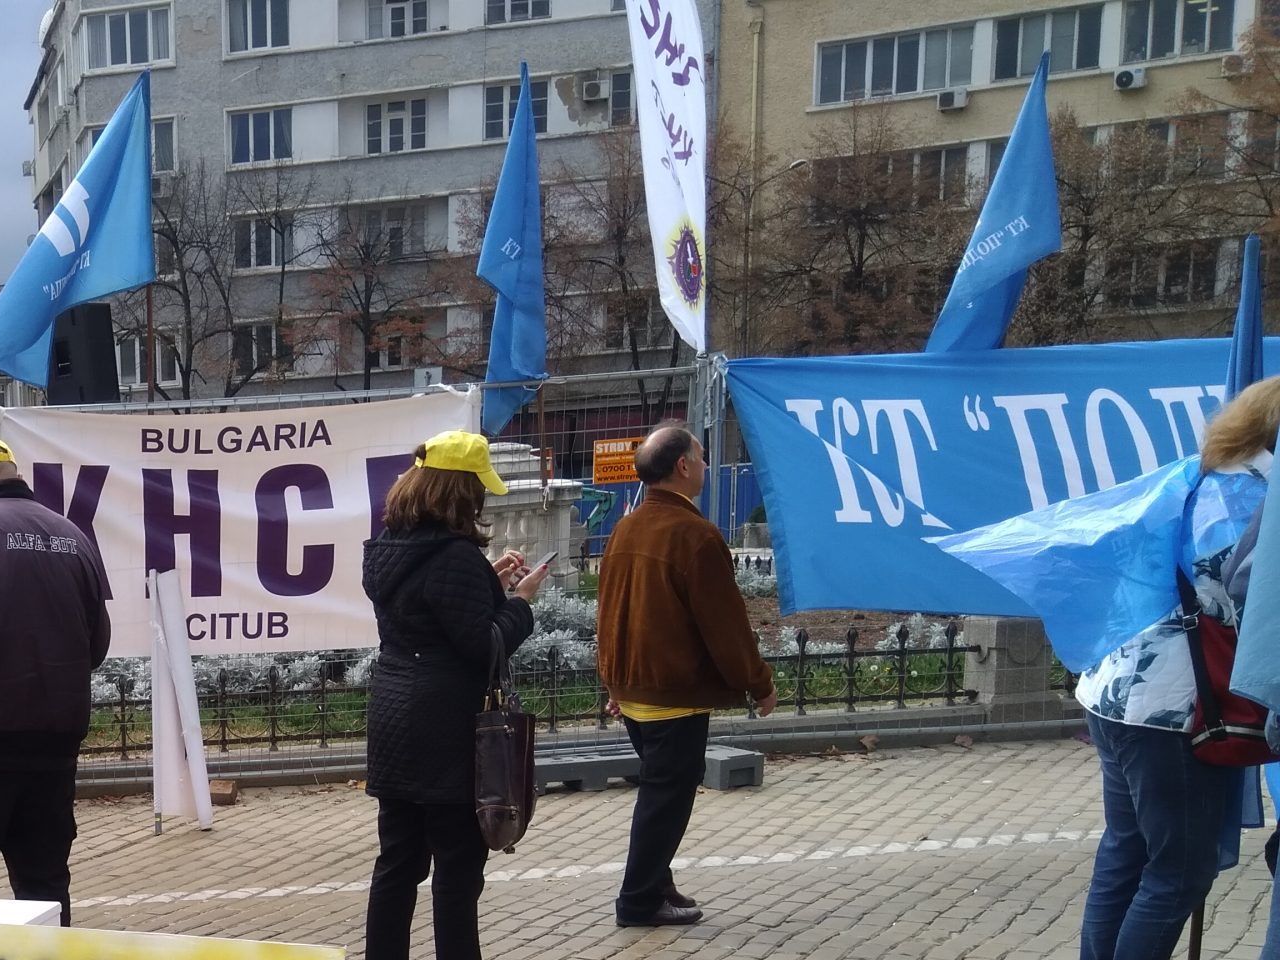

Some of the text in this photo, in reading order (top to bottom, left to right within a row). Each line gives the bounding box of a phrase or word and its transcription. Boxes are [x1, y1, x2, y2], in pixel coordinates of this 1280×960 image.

[141, 419, 333, 454] BULGARIA
[602, 464, 626, 473] 0700
[6, 532, 78, 555] ALFA SOT
[186, 612, 289, 641] CITUB
